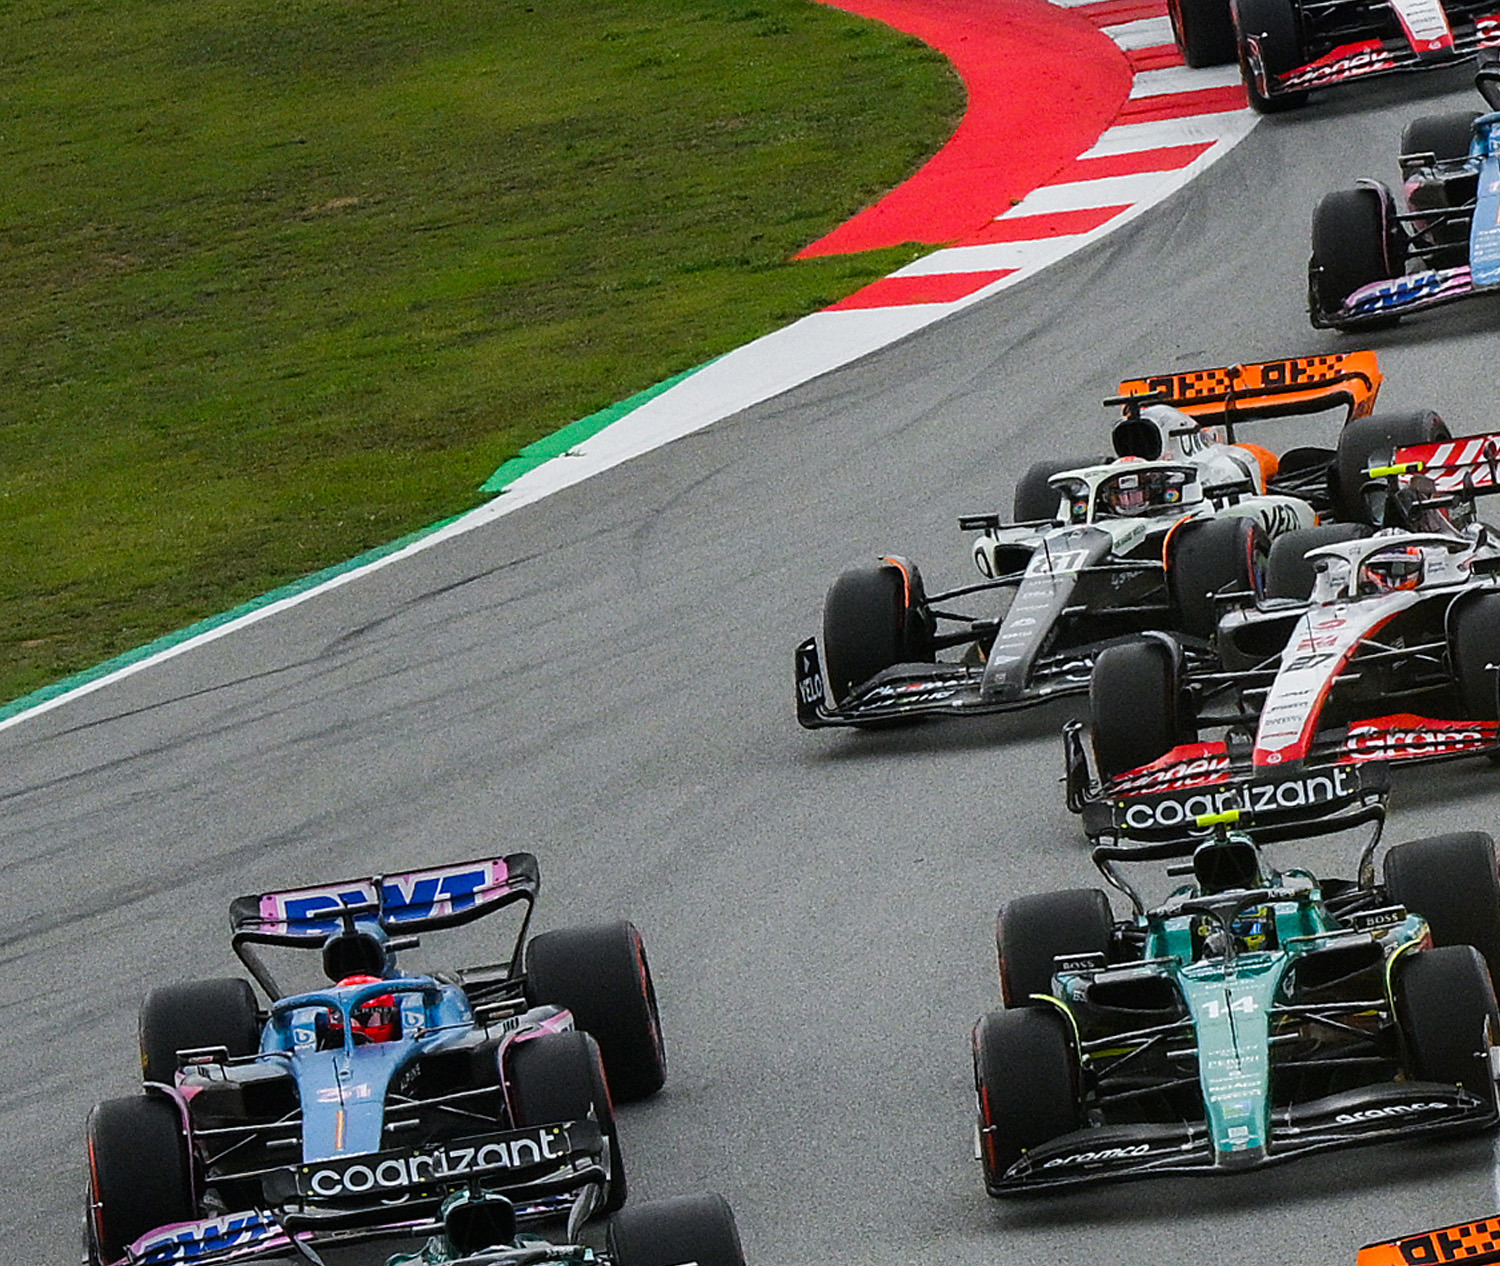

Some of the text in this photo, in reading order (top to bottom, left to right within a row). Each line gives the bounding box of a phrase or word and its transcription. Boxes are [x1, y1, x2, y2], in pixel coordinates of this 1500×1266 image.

[1125, 768, 1350, 834] cognizant
[1366, 911, 1399, 926] BOSS
[1202, 995, 1259, 1019] 14
[1335, 1100, 1449, 1125] aramco
[310, 1129, 558, 1205] cognizant
[1042, 1143, 1150, 1168] aramco
